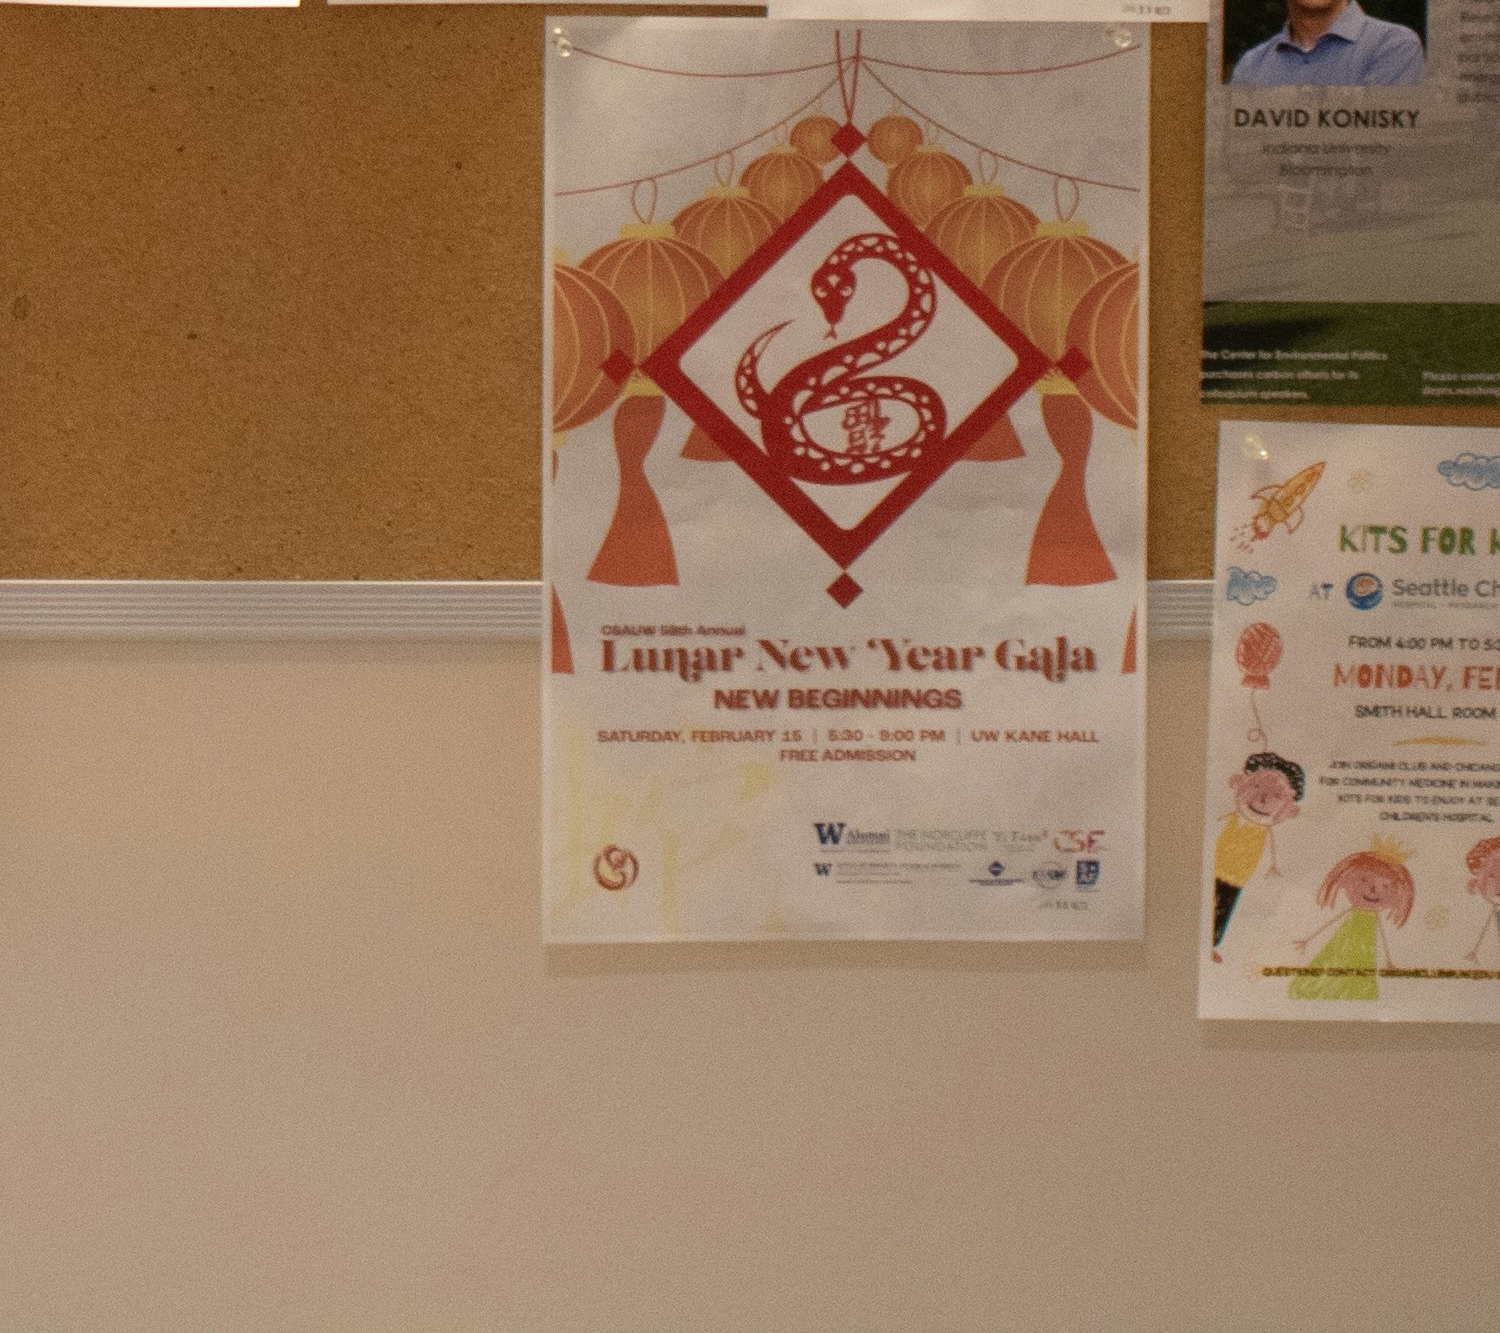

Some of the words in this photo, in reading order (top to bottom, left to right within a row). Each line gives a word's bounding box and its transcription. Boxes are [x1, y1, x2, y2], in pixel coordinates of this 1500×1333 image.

[1235, 110, 1312, 129] DAVID
[1319, 110, 1420, 131] KONISKY
[714, 689, 780, 710] NEW
[789, 689, 963, 711] BEGINNINGS
